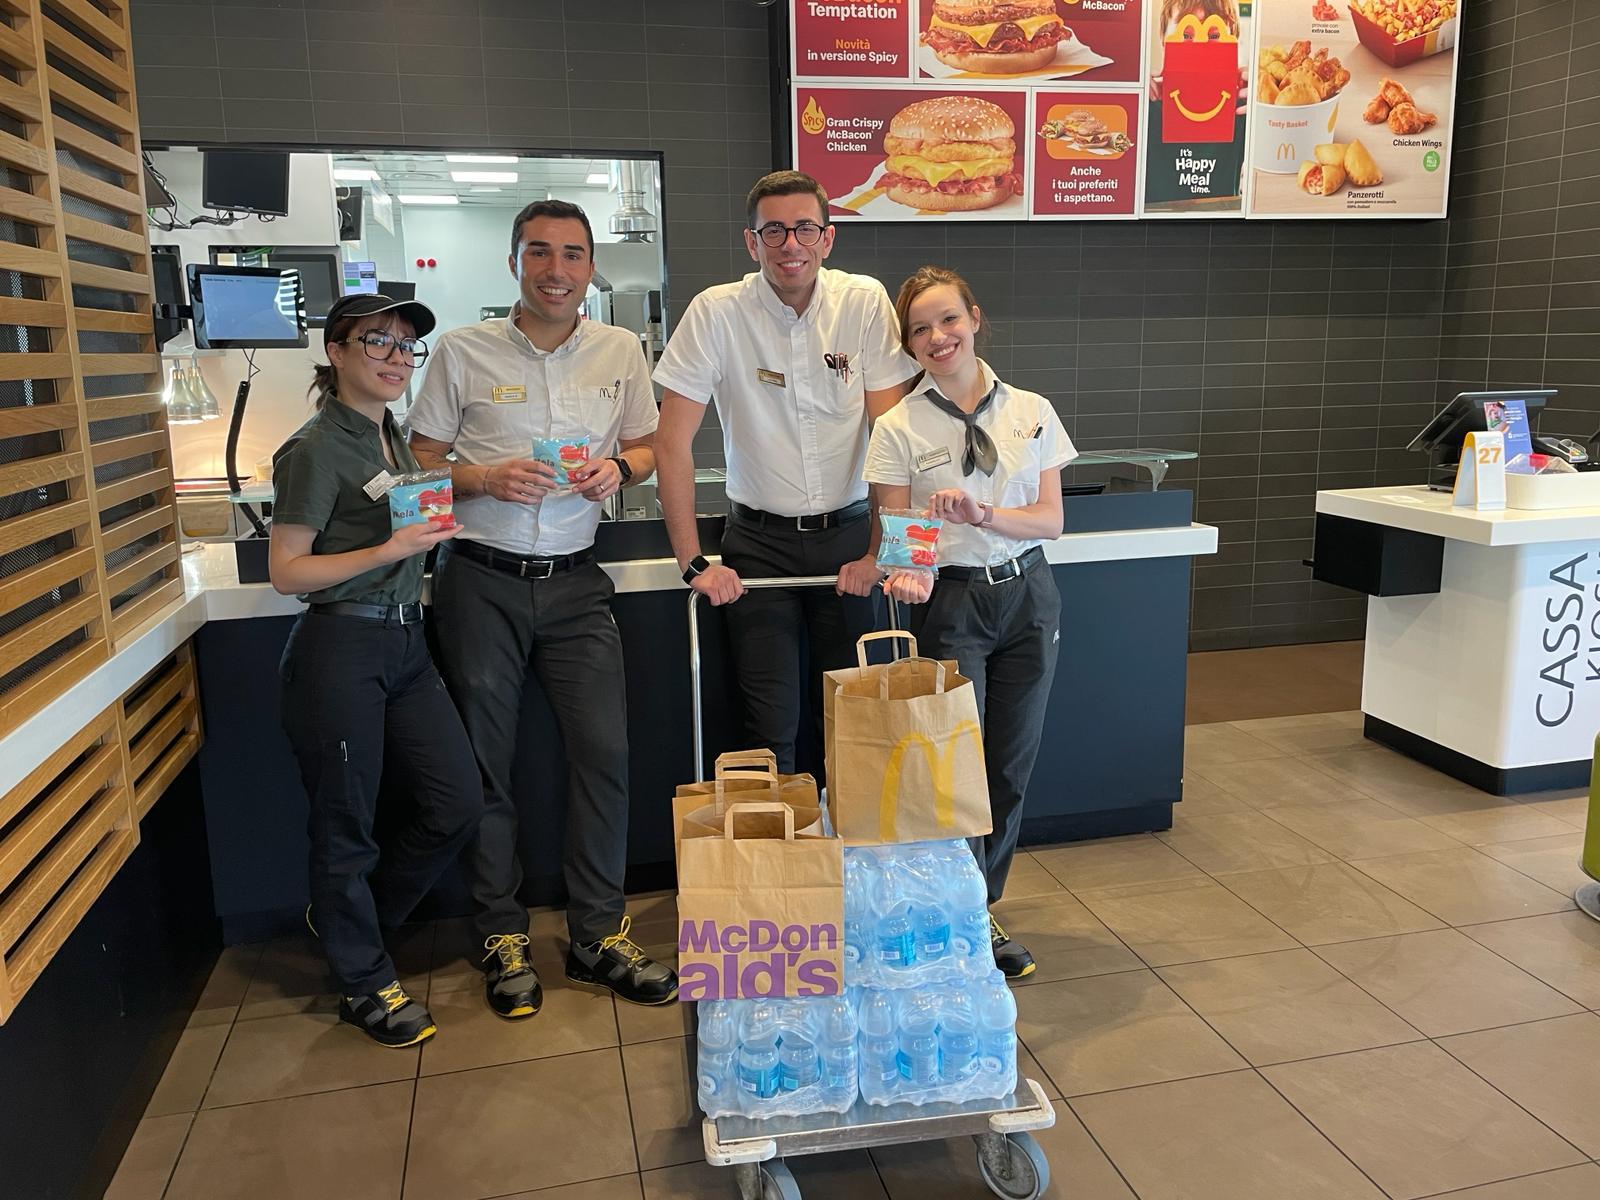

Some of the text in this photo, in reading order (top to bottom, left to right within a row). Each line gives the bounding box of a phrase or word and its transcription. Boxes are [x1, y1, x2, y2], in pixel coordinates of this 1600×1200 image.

[807, 2, 897, 21] Temptation
[1082, 1, 1126, 11] McBacon
[835, 39, 871, 50] Novità
[807, 50, 898, 65] in versione Spicy
[826, 117, 884, 130] Gran Crispy
[826, 130, 873, 140] McBacon
[826, 141, 868, 152] Chicken
[1392, 139, 1443, 149] Chicken Wings
[1179, 148, 1193, 157] It's
[1070, 165, 1102, 176] Anche
[1175, 157, 1217, 173] Happy
[1052, 178, 1118, 192] i tuoi preferiti
[1179, 172, 1211, 186] Meal
[1054, 192, 1115, 205] ti aspettano.
[1347, 190, 1384, 199] Panzerotti
[1478, 446, 1502, 465] 27
[1535, 552, 1588, 727] CASSA
[678, 919, 838, 953] McDon
[678, 952, 839, 1001] ald's
